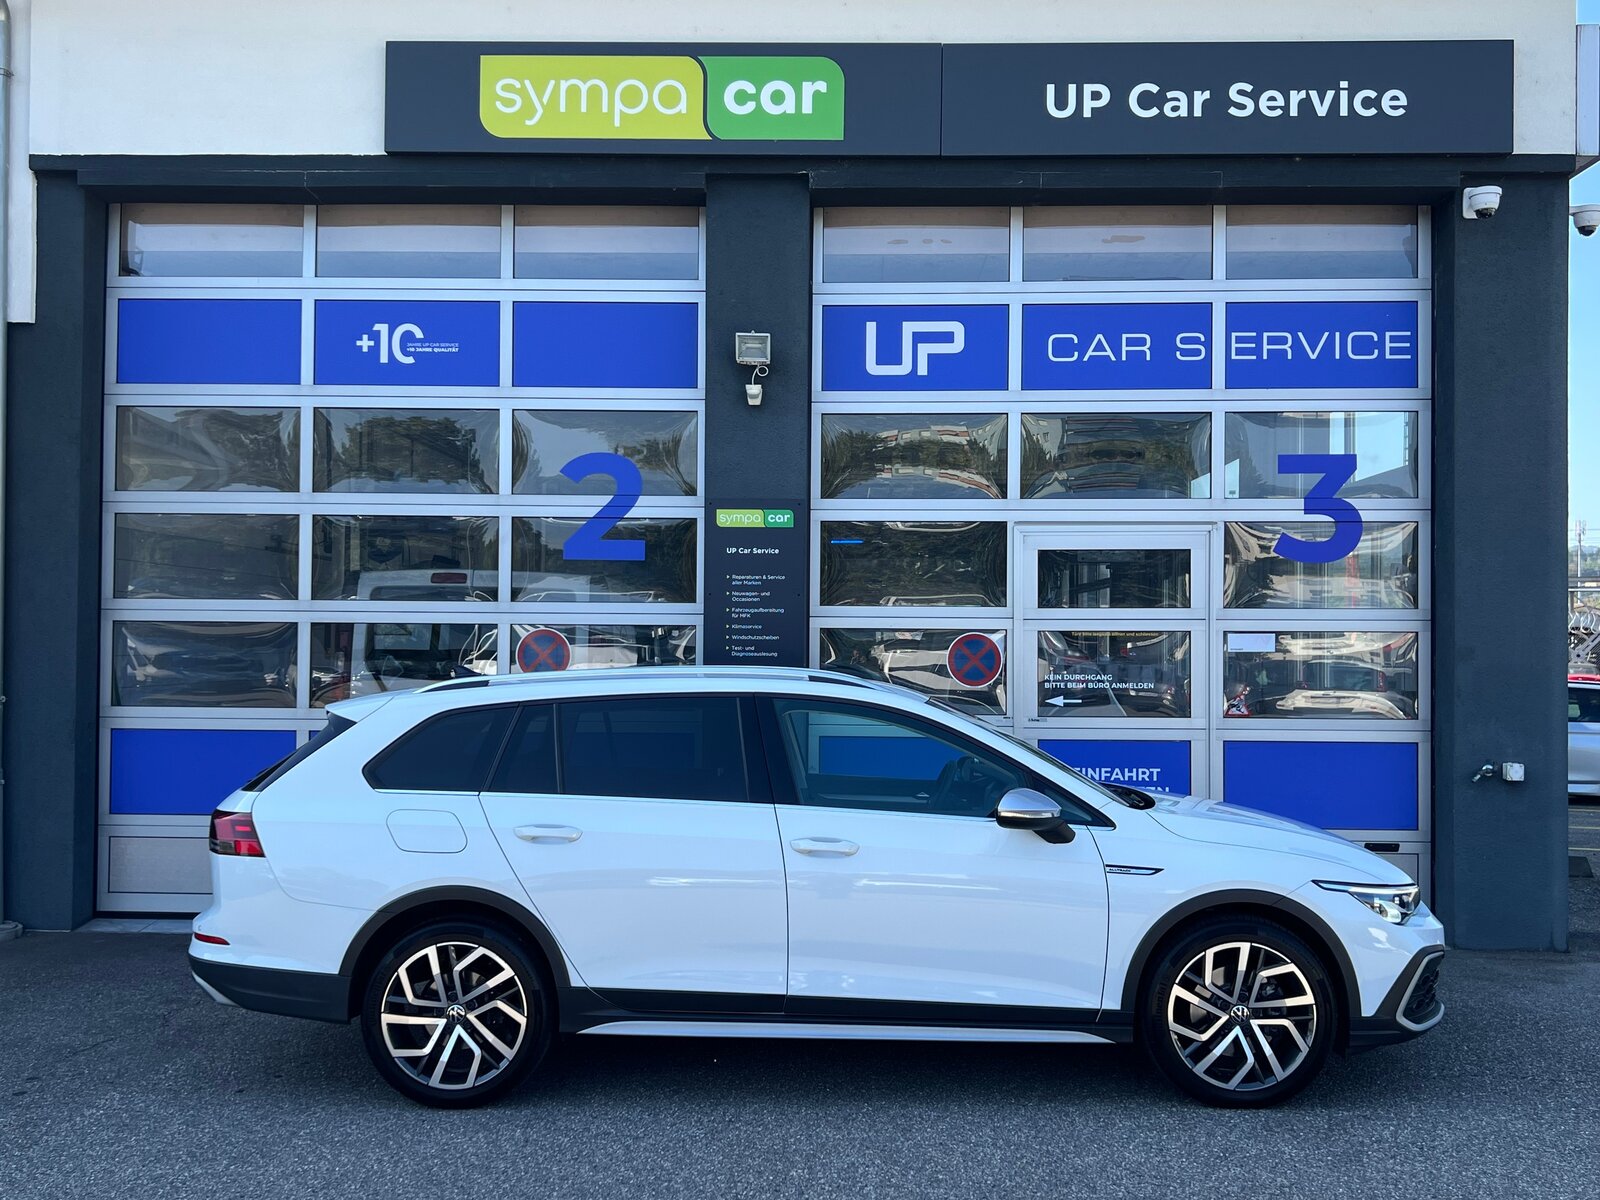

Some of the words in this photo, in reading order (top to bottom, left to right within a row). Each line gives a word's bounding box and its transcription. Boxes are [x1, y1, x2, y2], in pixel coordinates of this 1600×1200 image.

[495, 78, 688, 128] sympa
[723, 80, 828, 116] car
[1046, 83, 1112, 119] UP
[1128, 82, 1211, 119] Car
[1227, 80, 1409, 118] Service
[866, 321, 966, 377] UP
[1047, 333, 1152, 362] CAR
[560, 452, 646, 561] 2
[719, 513, 761, 525] sympa
[767, 514, 791, 523] car
[1272, 454, 1364, 564] 3
[752, 546, 780, 554] Service
[1088, 681, 1110, 689] BÜRO
